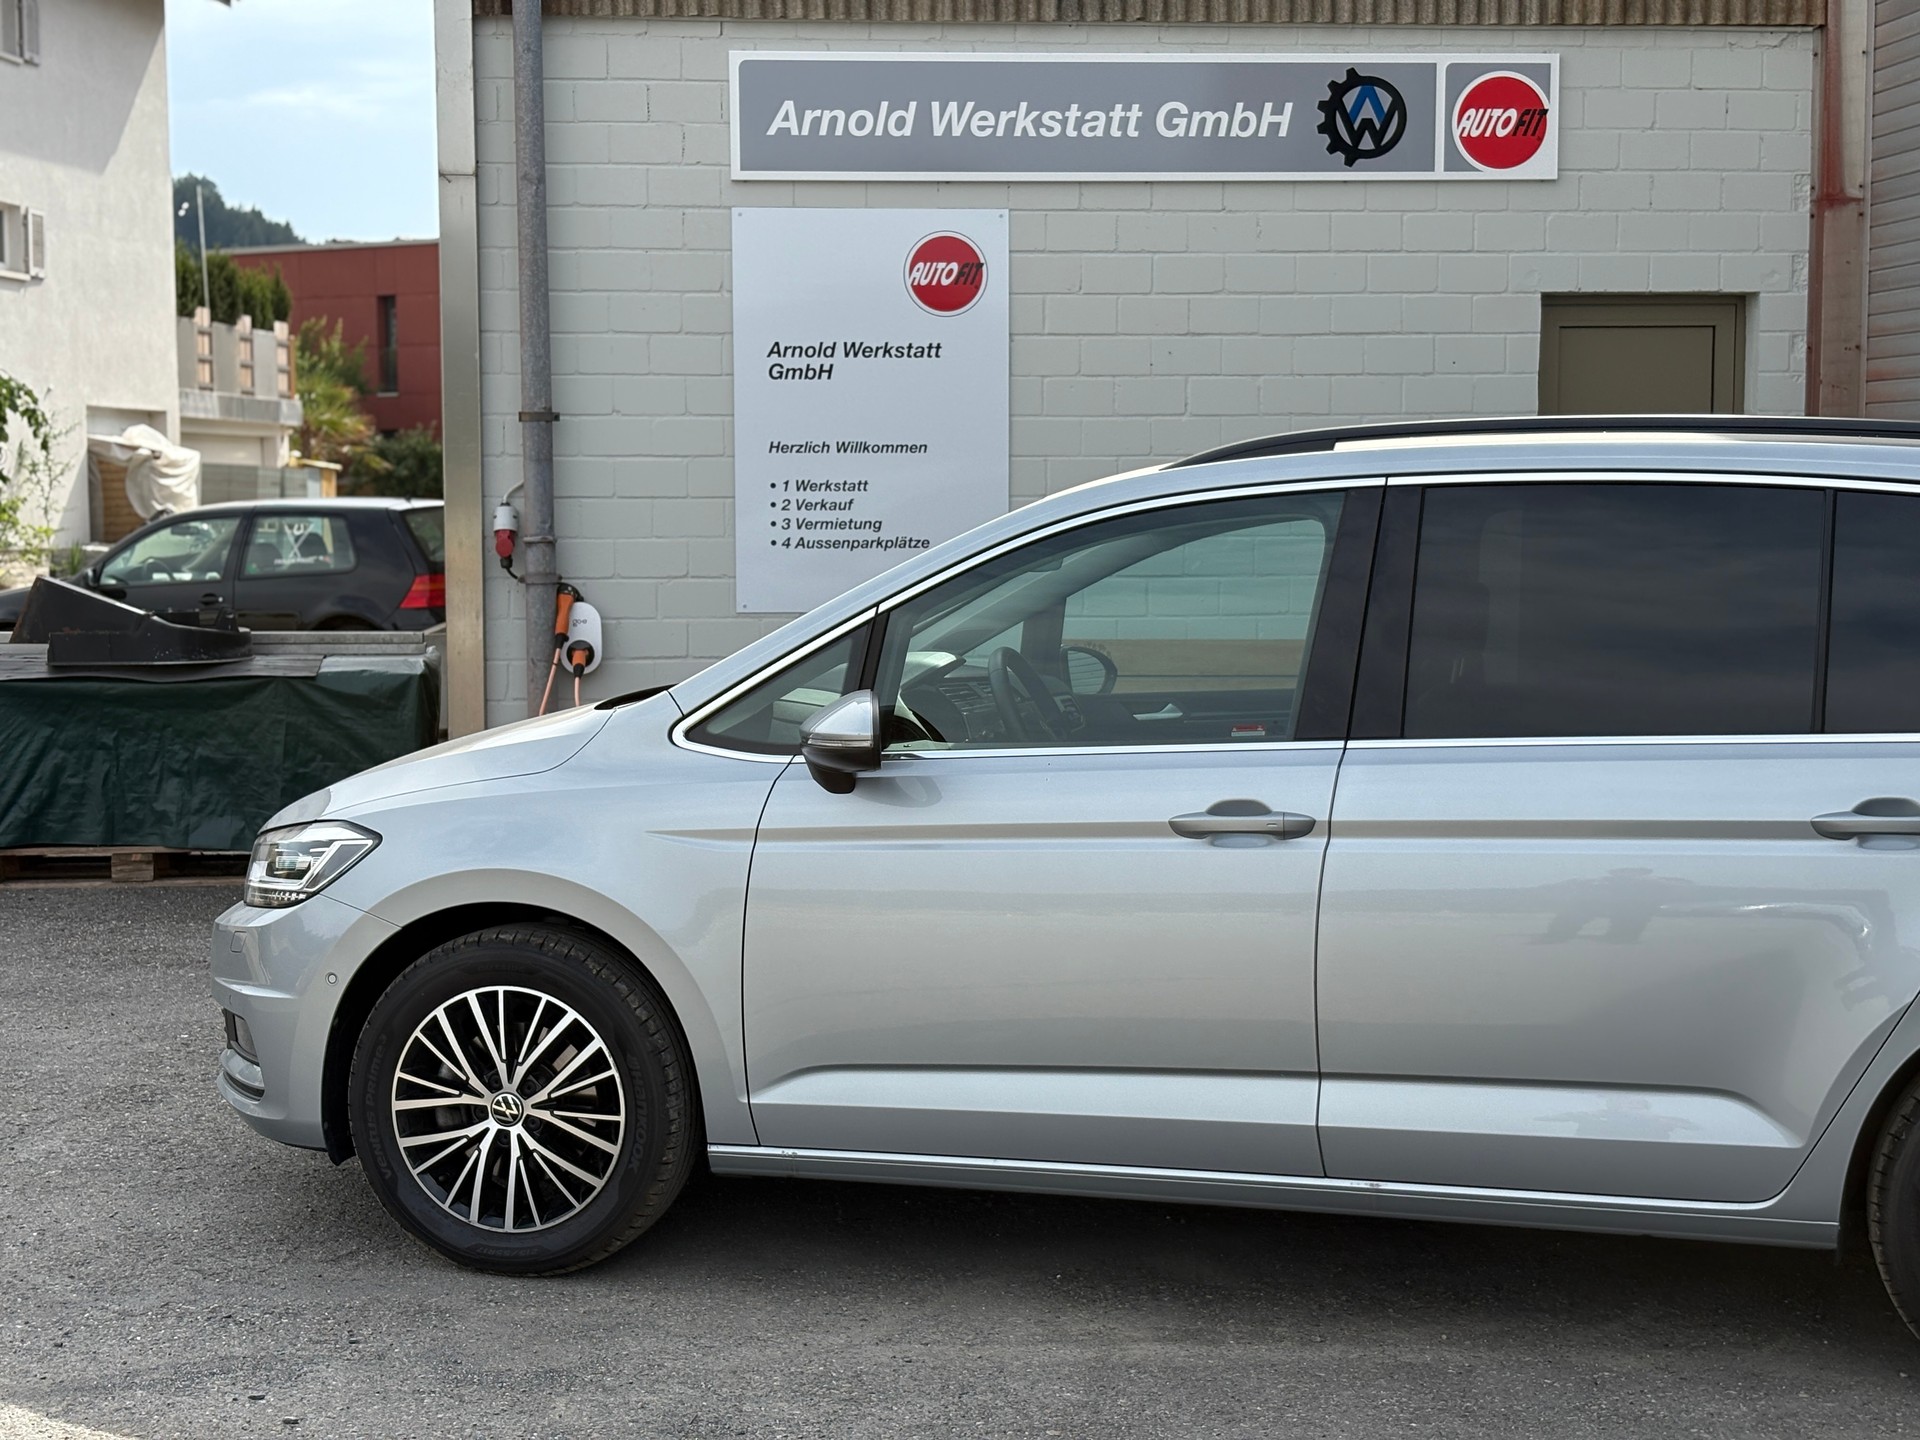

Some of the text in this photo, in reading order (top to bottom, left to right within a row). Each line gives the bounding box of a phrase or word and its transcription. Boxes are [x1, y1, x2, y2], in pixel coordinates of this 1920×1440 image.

[766, 100, 1293, 138] Arnold Werkstatt GmbH
[1457, 108, 1549, 138] AUTOFIT
[909, 261, 984, 287] AUTOFIT
[766, 341, 943, 359] Arnold Werkstatt
[768, 362, 834, 381] GmbH
[768, 440, 928, 454] Herzlich Willkommen
[782, 479, 869, 492] 1 Werkstatt
[781, 498, 855, 512] 2 Verkauf
[781, 517, 883, 533] 3 Vermietung
[781, 536, 930, 552] 4 Aussenparkplätze
